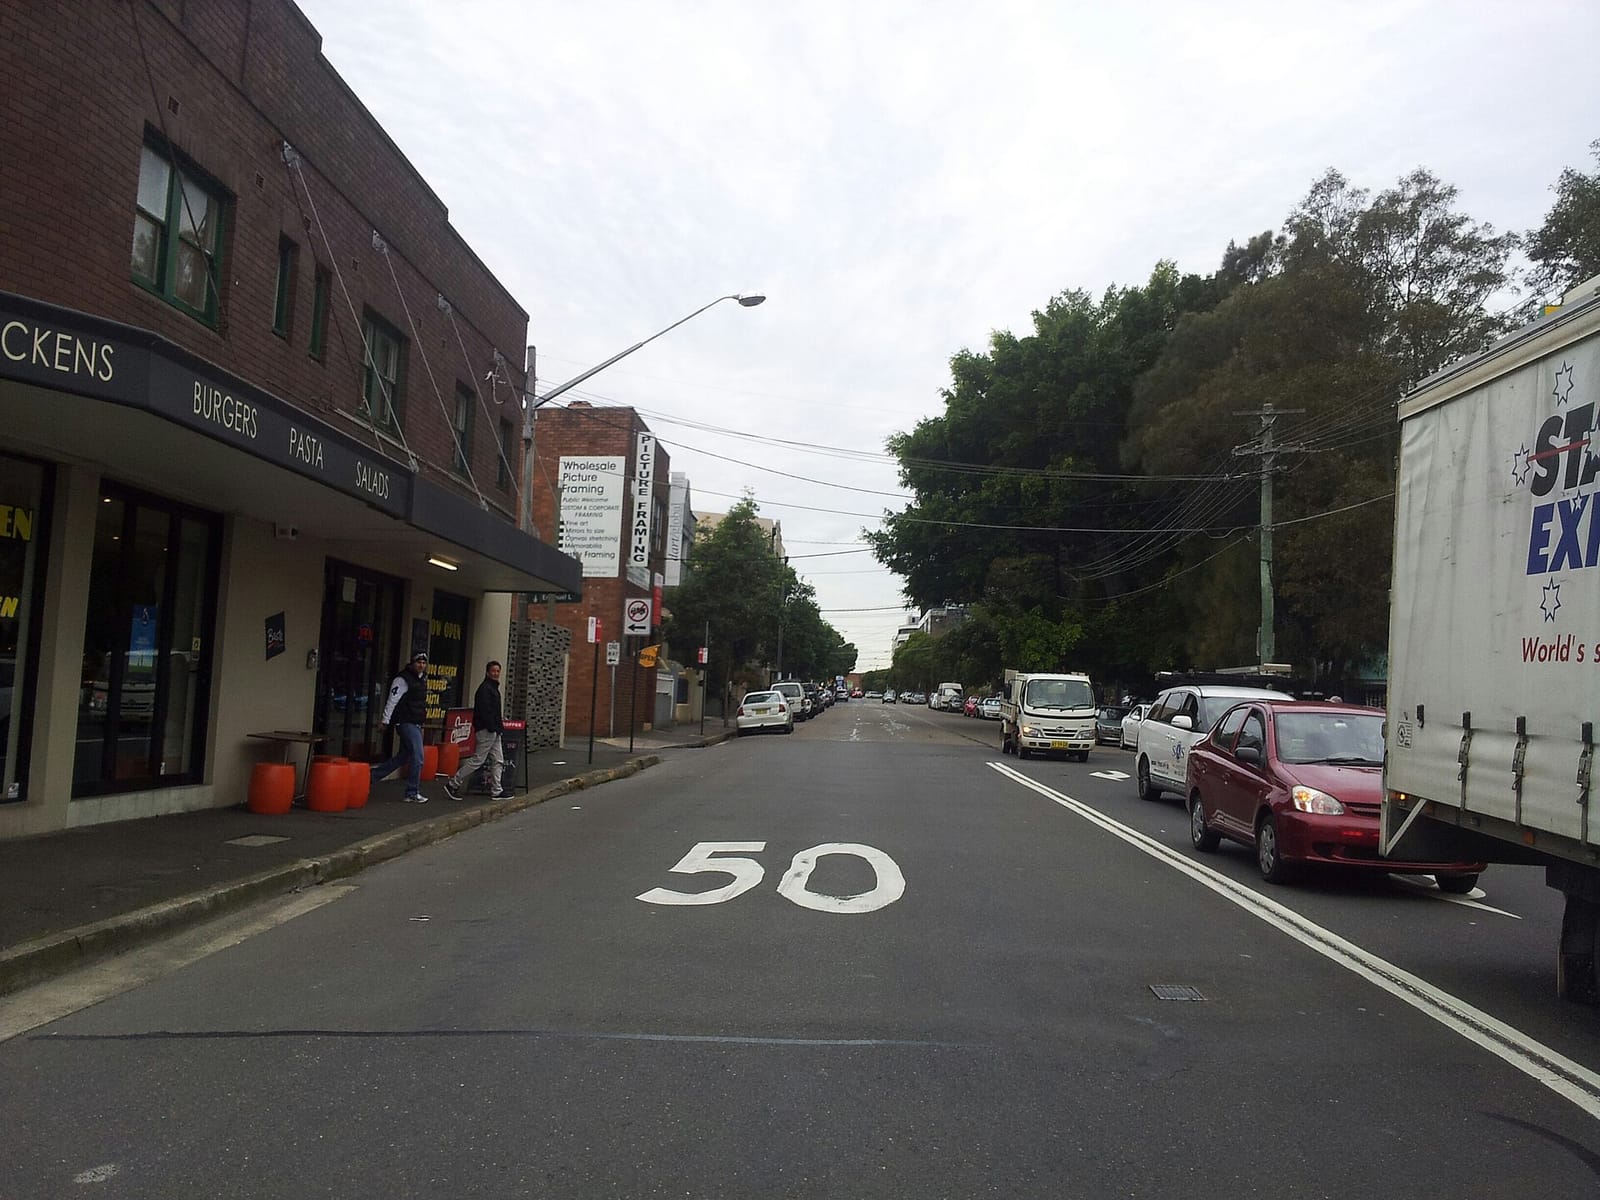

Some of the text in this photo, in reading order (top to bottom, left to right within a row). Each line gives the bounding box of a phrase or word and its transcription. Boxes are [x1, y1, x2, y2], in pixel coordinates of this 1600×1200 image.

[1, 321, 114, 382] CKENS
[193, 380, 390, 500] BURGERS PASTA SALADS
[563, 461, 617, 471] Wholesale
[563, 473, 598, 482] Picture
[638, 436, 651, 496] PICTURE
[562, 484, 605, 495] Framing
[633, 502, 648, 562] FRAMING
[584, 551, 615, 560] Framing
[1522, 633, 1585, 663] World's
[635, 842, 906, 913] 50
